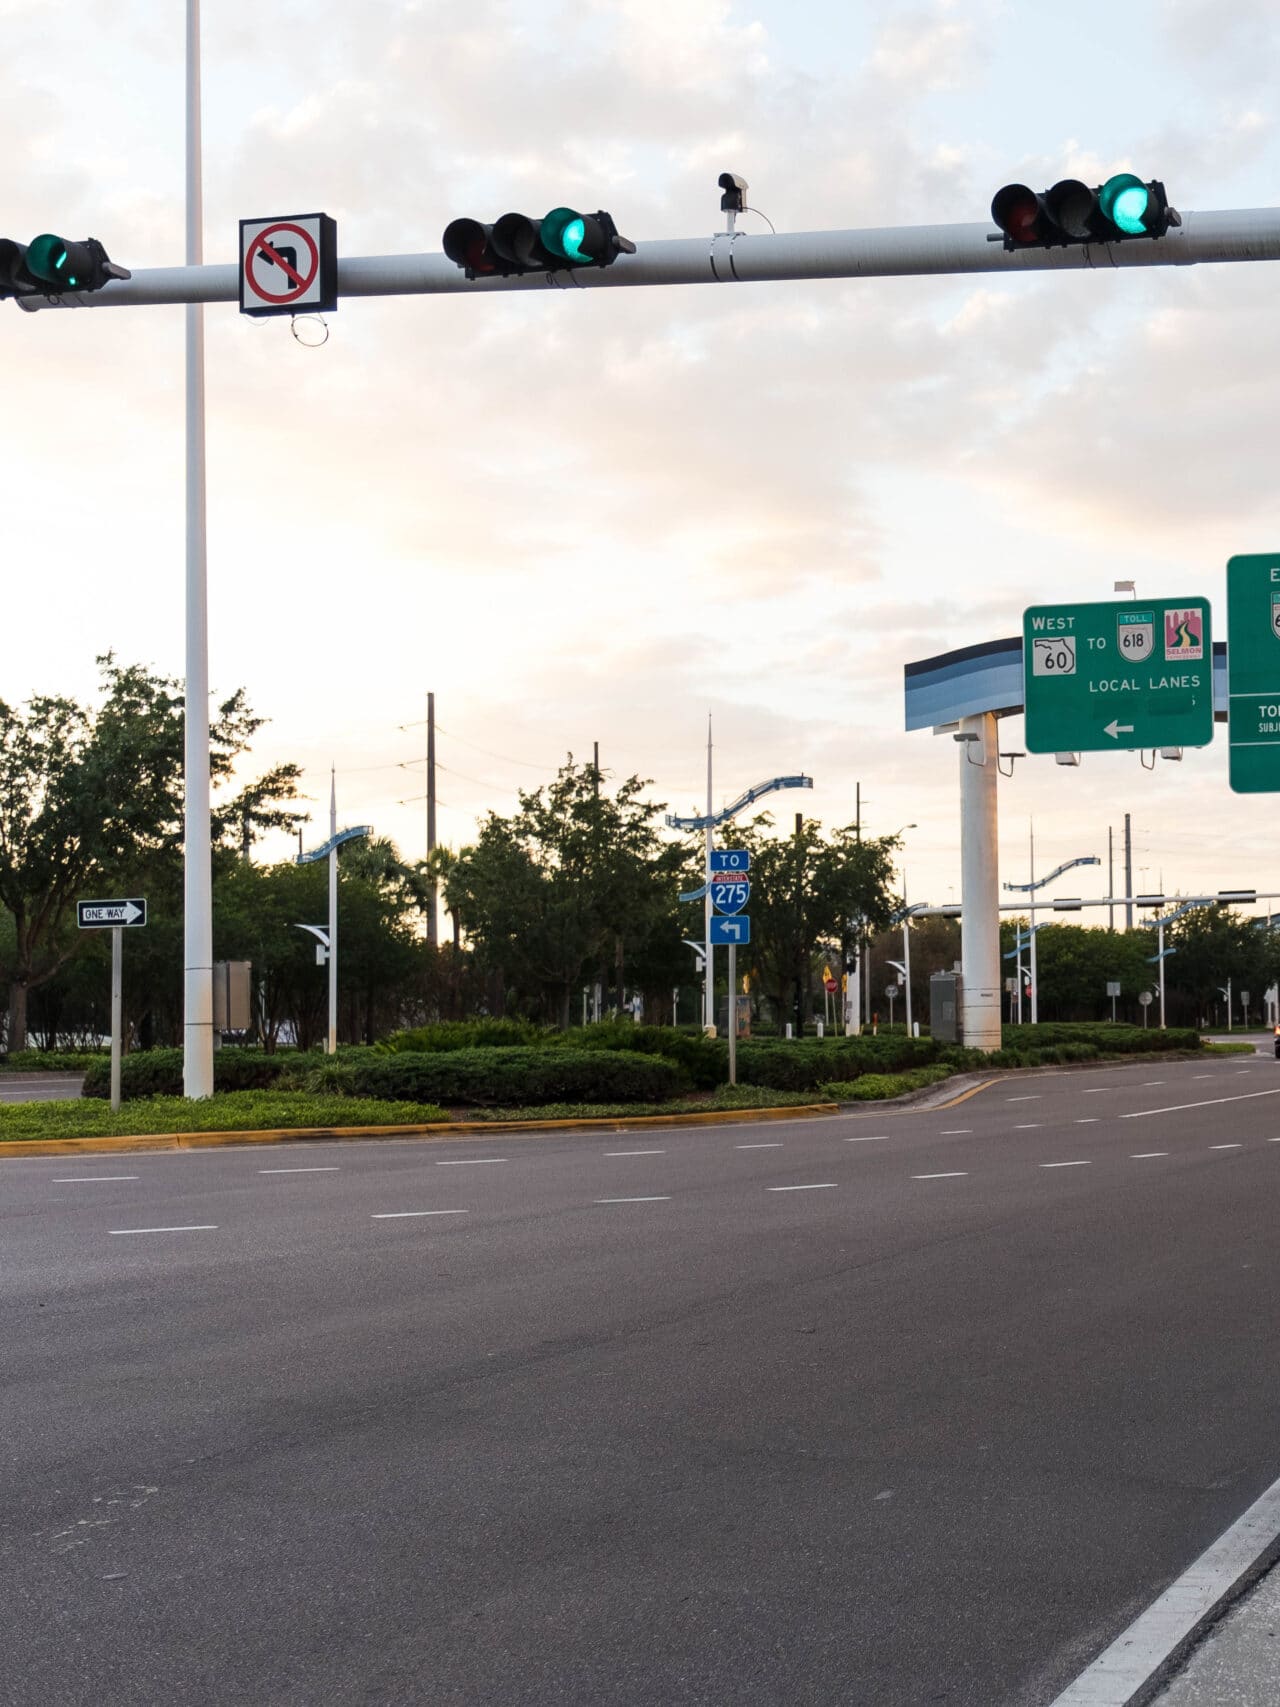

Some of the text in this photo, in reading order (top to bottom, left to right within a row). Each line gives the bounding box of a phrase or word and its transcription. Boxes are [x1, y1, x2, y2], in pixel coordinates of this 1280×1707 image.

[1031, 616, 1076, 631] WEST
[1123, 614, 1148, 623] TOLL
[1087, 637, 1106, 650] TO
[1122, 633, 1144, 648] 618
[1045, 651, 1067, 670] 60
[1089, 675, 1201, 692] LOCAL LANES
[720, 854, 740, 867] TO
[716, 884, 746, 904] 275
[85, 908, 125, 919] ONE WAY
